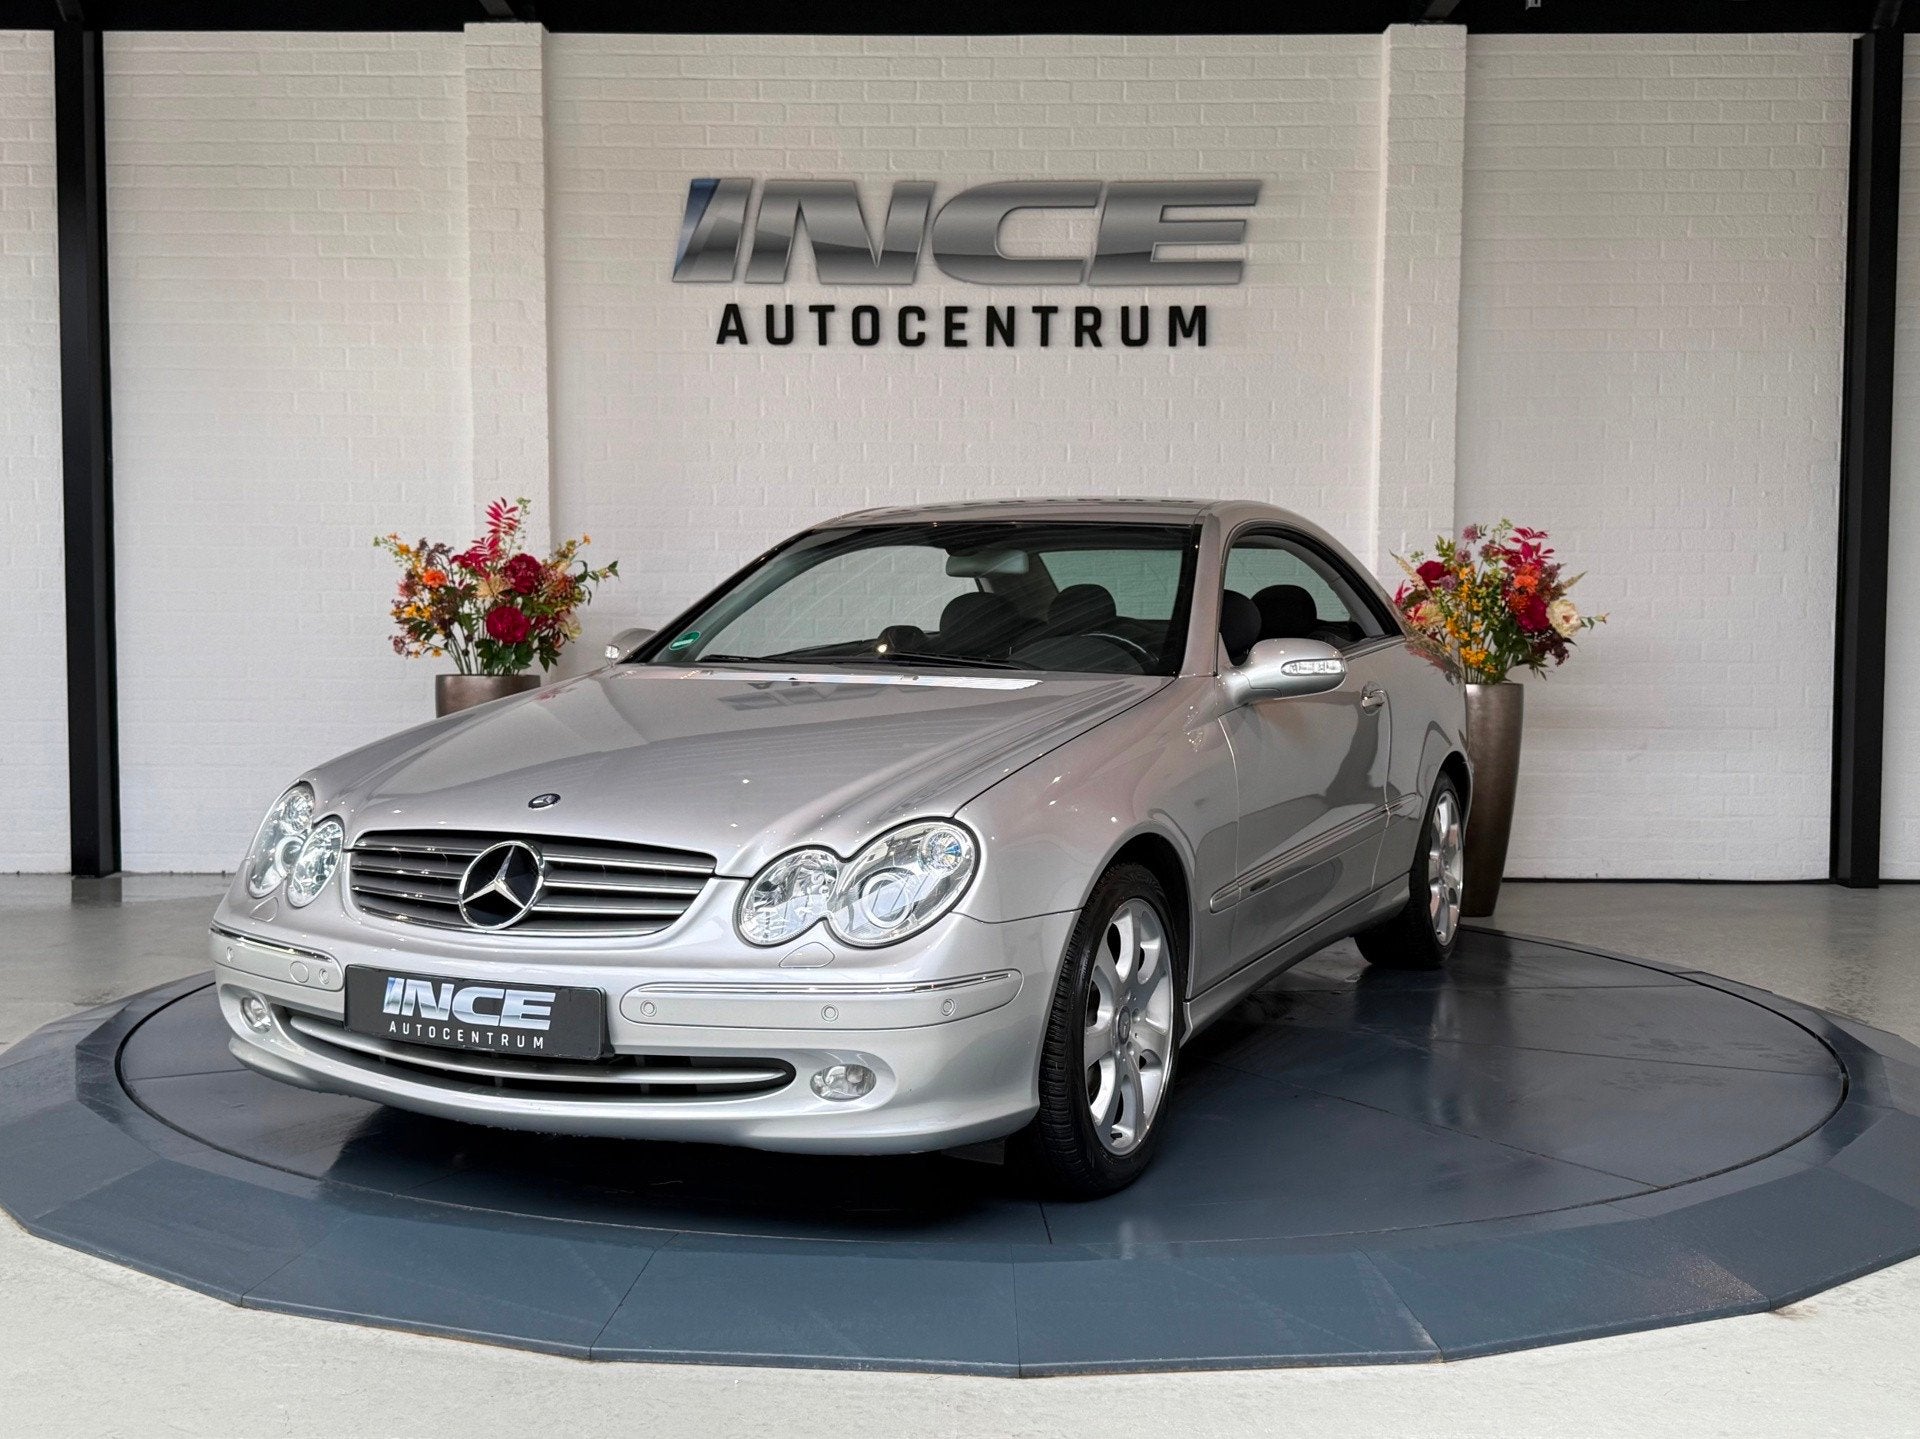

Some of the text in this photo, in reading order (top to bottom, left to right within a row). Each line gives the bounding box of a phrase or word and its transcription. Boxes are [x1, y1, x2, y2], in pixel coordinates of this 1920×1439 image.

[673, 178, 1262, 285] INCE
[716, 304, 1207, 347] AUTOCENTRUM
[382, 977, 556, 1030] INCE
[389, 1020, 544, 1049] AUTOCENTRUM
